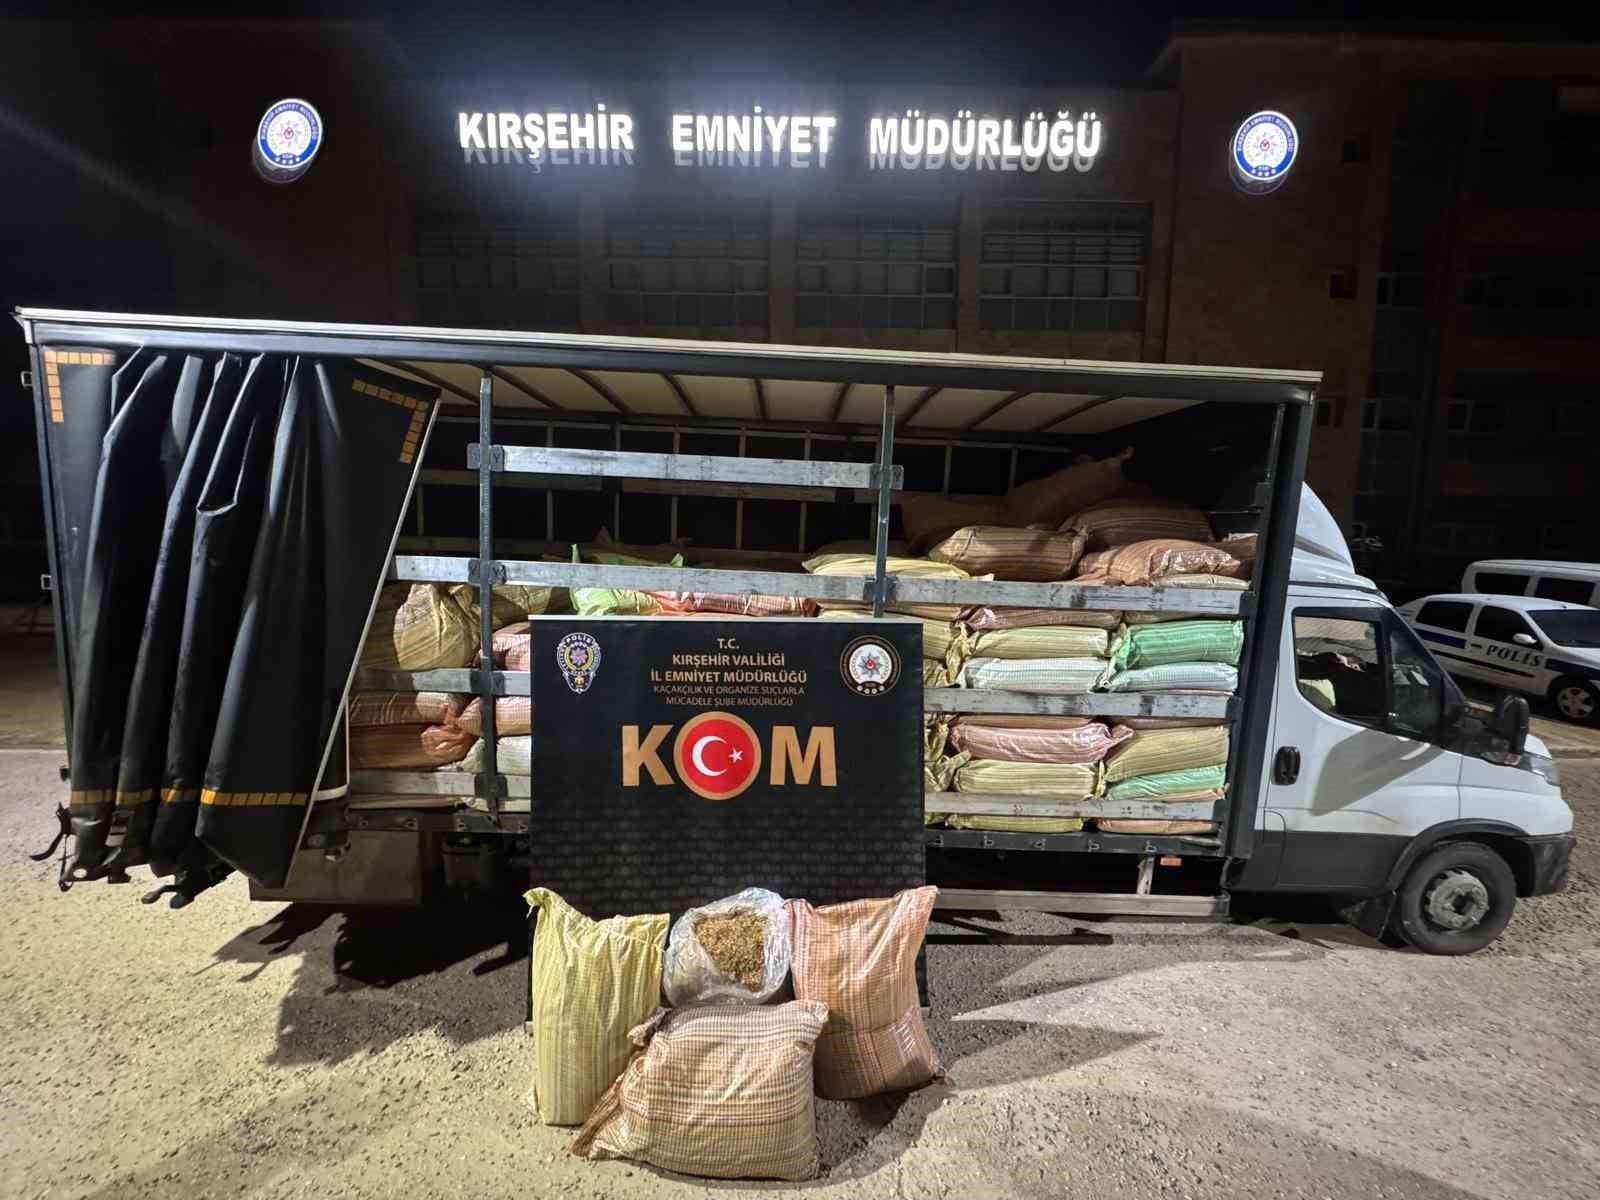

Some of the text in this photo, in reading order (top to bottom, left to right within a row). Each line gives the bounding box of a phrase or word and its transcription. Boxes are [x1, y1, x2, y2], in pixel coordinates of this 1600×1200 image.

[459, 104, 1101, 159] KIRŞEHİR EMNİYET MÜDÜRLÜĞÜ
[717, 638, 740, 649] T.C.
[672, 652, 785, 668] KIRŞEHİR VALİLİĞİ
[651, 668, 807, 684] İL EMNİYET MÜDÜRLÜĞÜ
[703, 686, 714, 694] VE
[715, 685, 760, 695] ORGANİZE
